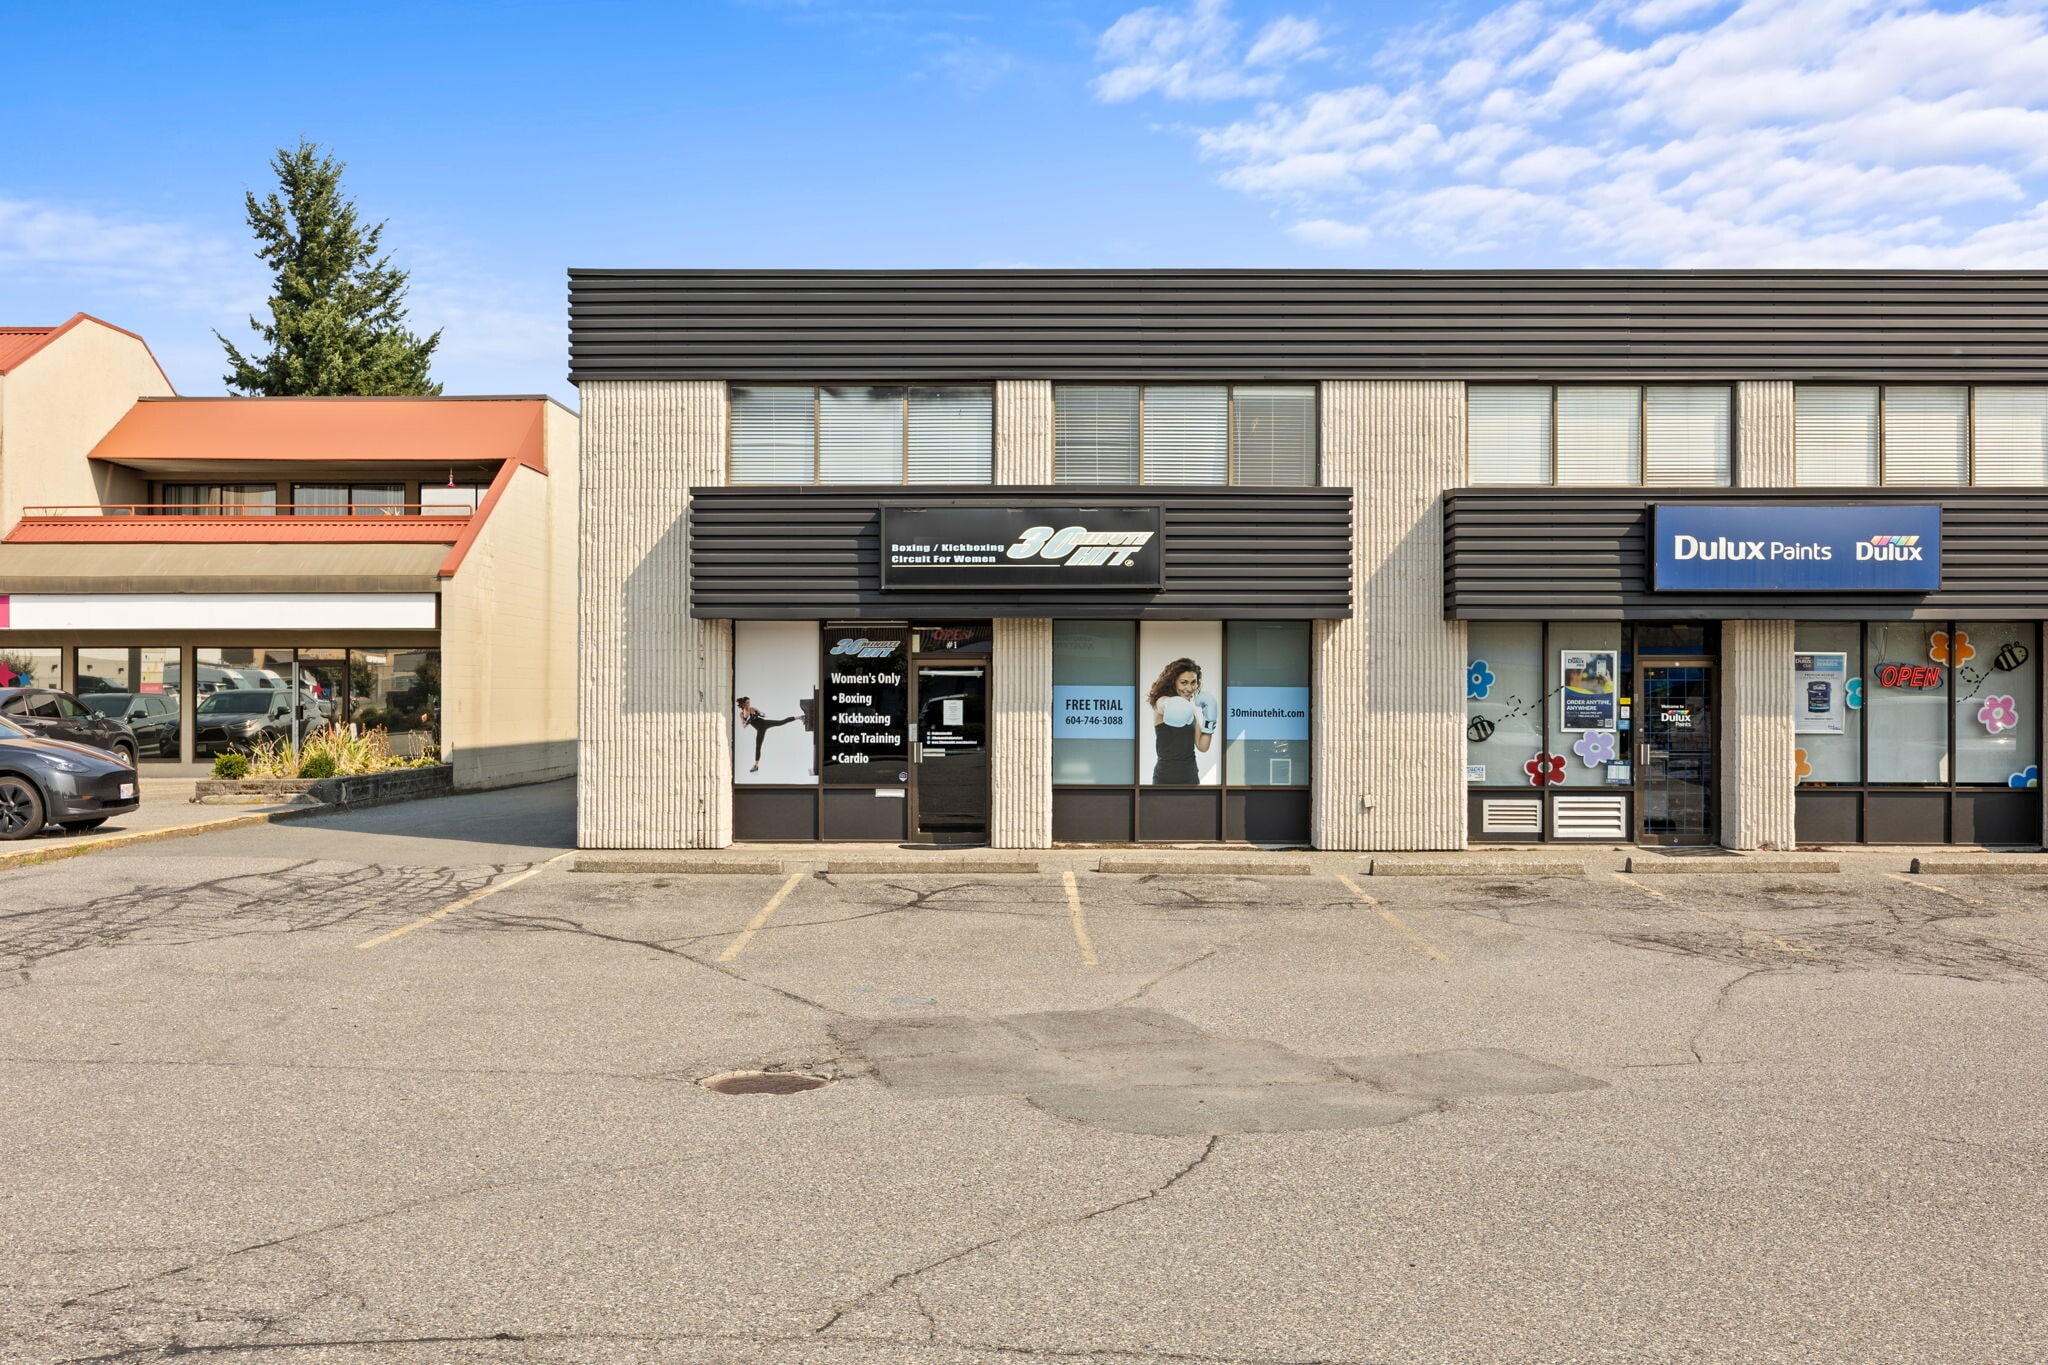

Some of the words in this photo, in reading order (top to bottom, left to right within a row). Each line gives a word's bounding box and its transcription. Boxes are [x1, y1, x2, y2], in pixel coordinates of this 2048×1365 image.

[891, 543, 931, 553] Boxing
[941, 543, 1005, 553] Kickboxing
[1006, 526, 1087, 559] 30
[1674, 535, 1765, 561] Dulux
[1770, 541, 1832, 561] Paints
[1856, 541, 1923, 561] Dulux
[891, 555, 931, 564] Circuit
[933, 555, 951, 564] For
[952, 555, 996, 564] Women
[830, 638, 868, 655] 30
[946, 641, 958, 649] #1
[831, 672, 876, 684] Women's
[877, 672, 901, 686] Only
[1880, 665, 1941, 688] OPEN
[838, 693, 872, 706] Boxing
[1065, 699, 1091, 711] FREE
[1093, 699, 1123, 711] TRIAL
[1230, 707, 1305, 718] 30minutehit.com
[1661, 712, 1691, 722] Dulux
[838, 713, 891, 726] Kickboxing
[1065, 716, 1123, 725] 604-746-3088
[838, 732, 859, 744] Core
[861, 732, 901, 746] Training
[838, 752, 869, 764] Cardio
